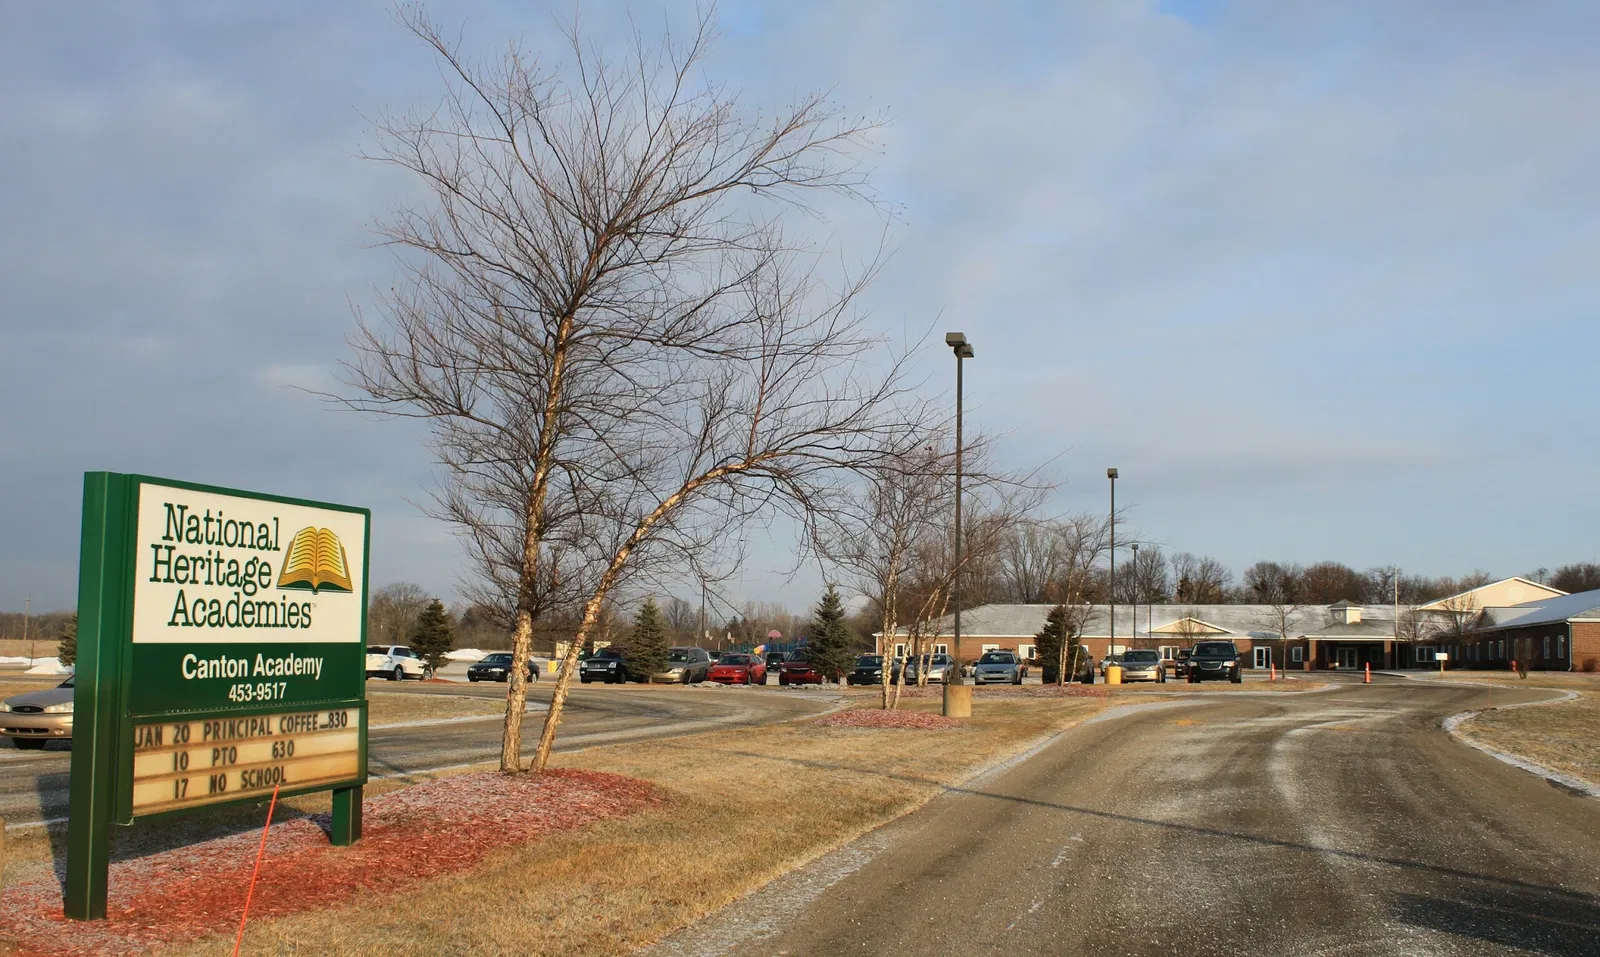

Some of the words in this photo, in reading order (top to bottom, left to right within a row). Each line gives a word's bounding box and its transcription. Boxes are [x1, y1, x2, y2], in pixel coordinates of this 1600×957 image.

[162, 502, 280, 551] National
[149, 544, 272, 596] Heritage
[167, 589, 311, 629] Academies
[182, 653, 248, 680] Canton
[252, 653, 323, 681] Academy
[228, 682, 287, 702] 453-9517
[134, 727, 163, 748] JAN
[172, 724, 190, 745] 20
[203, 717, 273, 742] PRINCIPAL
[173, 751, 189, 772] 10
[212, 746, 238, 767] PTO
[272, 739, 295, 760] 630
[174, 778, 188, 800] 17
[209, 773, 227, 794] NO
[240, 765, 287, 790] SCHOOL
